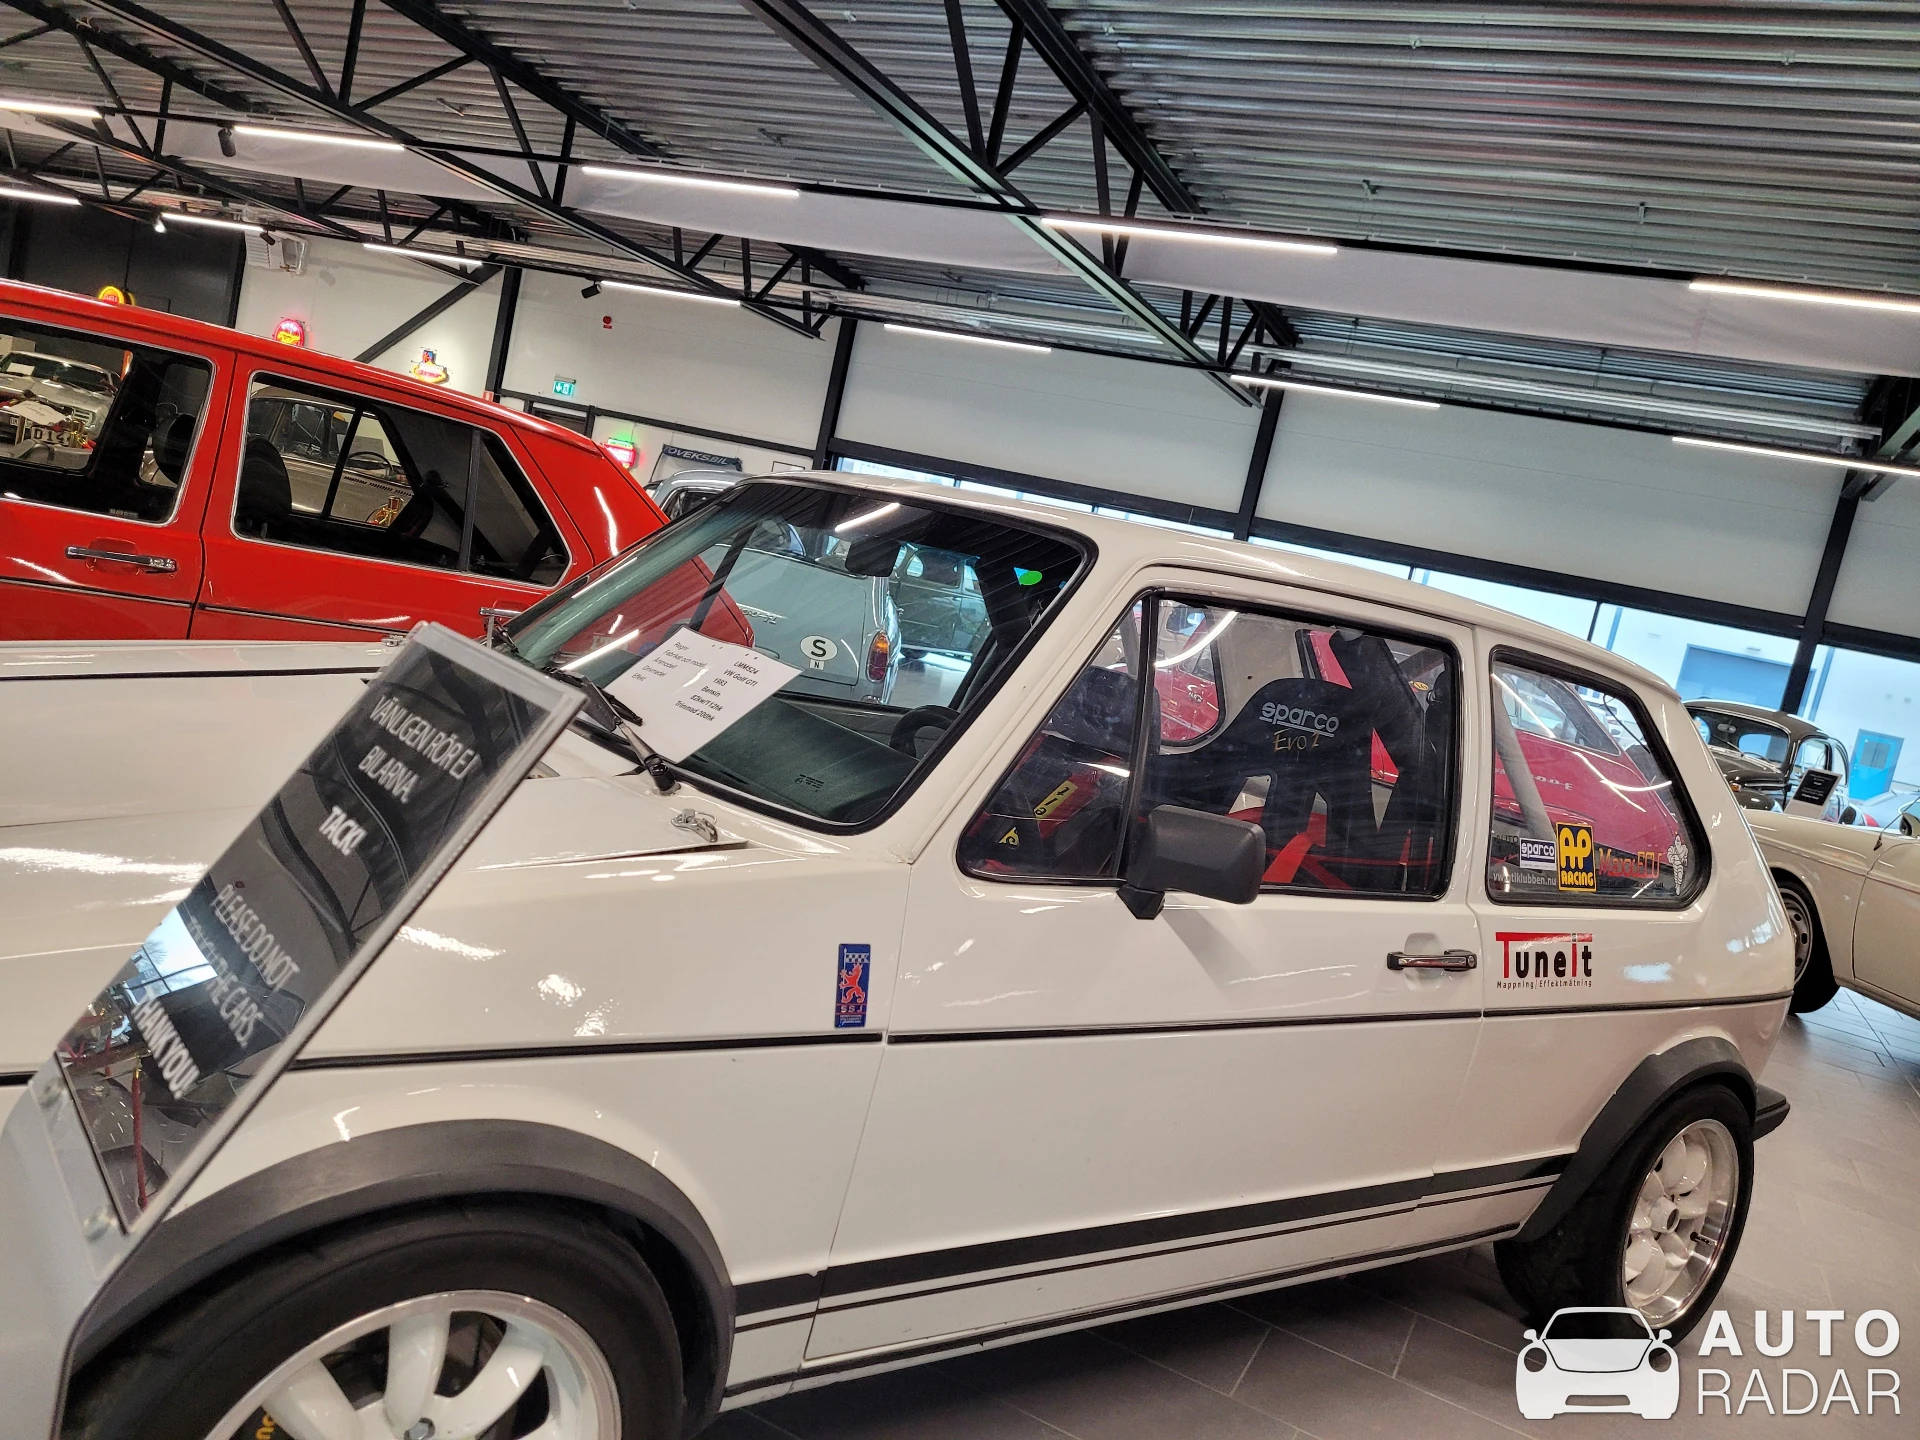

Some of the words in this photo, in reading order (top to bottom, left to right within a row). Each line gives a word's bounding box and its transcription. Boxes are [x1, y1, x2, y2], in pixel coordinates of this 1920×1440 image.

[810, 639, 826, 657] S
[814, 661, 820, 669] N
[701, 686, 721, 697] Bensin
[733, 673, 747, 682] Golf
[745, 679, 758, 687] GTI
[1260, 702, 1339, 733] sparco
[370, 695, 435, 751] VÄNLIGEN
[422, 731, 464, 771] RÖR
[449, 748, 481, 780] EJ
[319, 805, 368, 856] TACK!
[1521, 842, 1555, 858] sparco
[1560, 827, 1591, 870] AP
[1561, 870, 1594, 887] RACING
[210, 883, 259, 943] PLEASE
[241, 924, 275, 963] DO
[262, 945, 300, 994] NOT
[158, 1036, 200, 1099] YOU!
